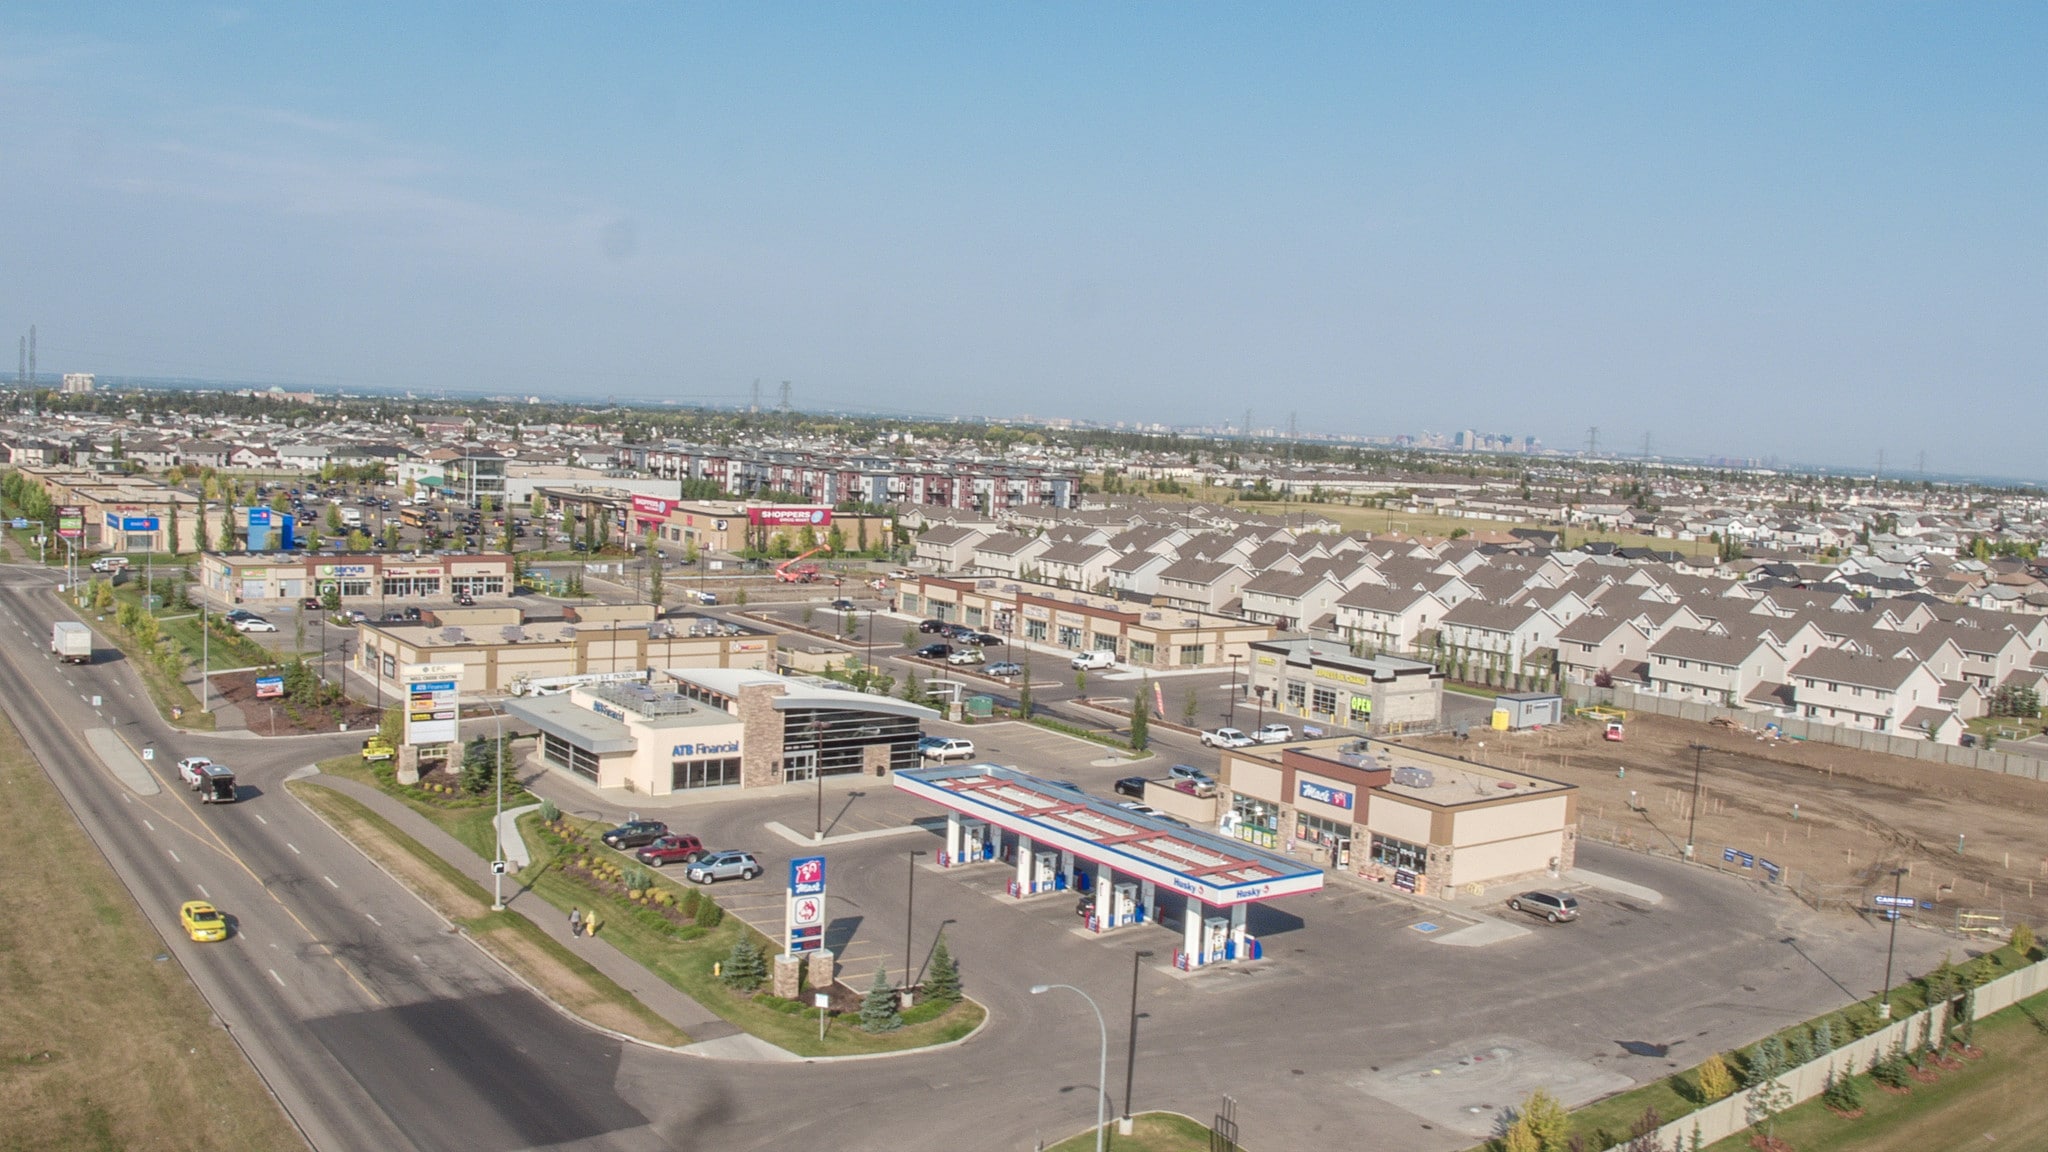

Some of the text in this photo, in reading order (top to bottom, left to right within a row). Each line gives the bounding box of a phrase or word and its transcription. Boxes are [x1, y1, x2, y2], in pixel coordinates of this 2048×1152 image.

[761, 510, 811, 519] SHOPPERS
[1351, 697, 1372, 712] OPEN
[672, 741, 739, 757] ATB Financial
[1173, 877, 1196, 893] Husky
[1236, 888, 1261, 898] Husky
